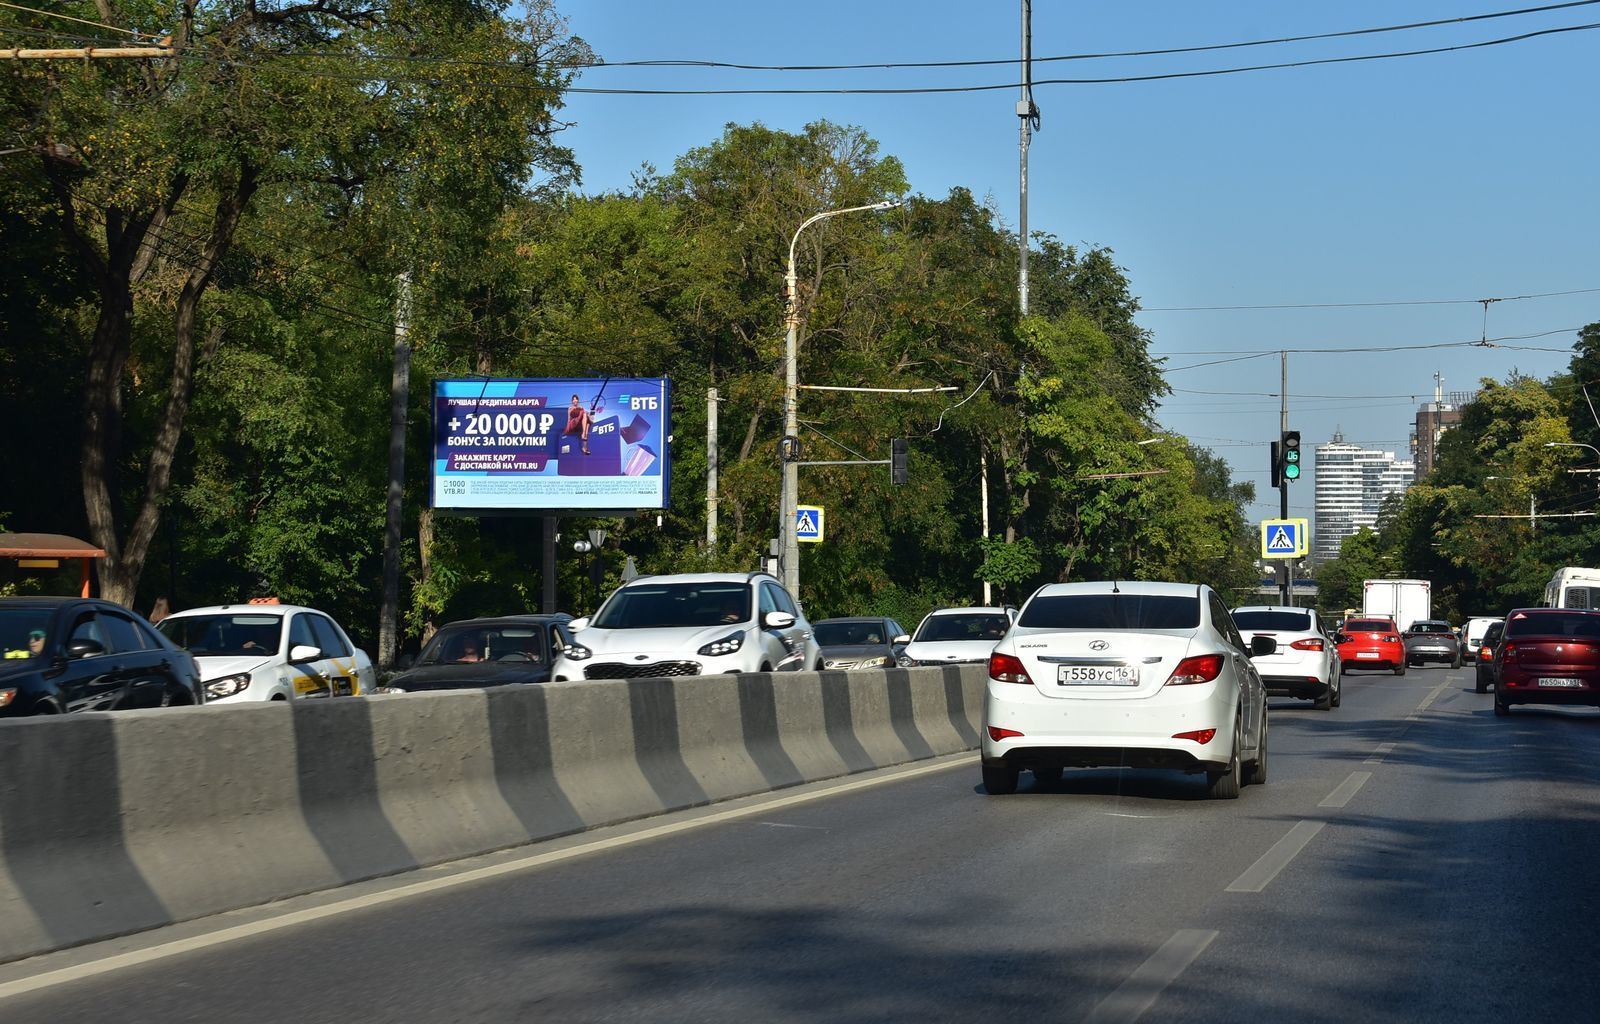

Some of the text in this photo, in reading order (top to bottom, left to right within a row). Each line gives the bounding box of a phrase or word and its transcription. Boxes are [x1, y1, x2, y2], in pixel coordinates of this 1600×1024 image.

[631, 398, 658, 409] ВТБ
[598, 423, 615, 434] ВТБ
[447, 437, 547, 446] БОНУС ЗА ПОКУПКИ
[1288, 451, 1298, 460] 06
[460, 462, 502, 470] ДОСТАВКОЙ
